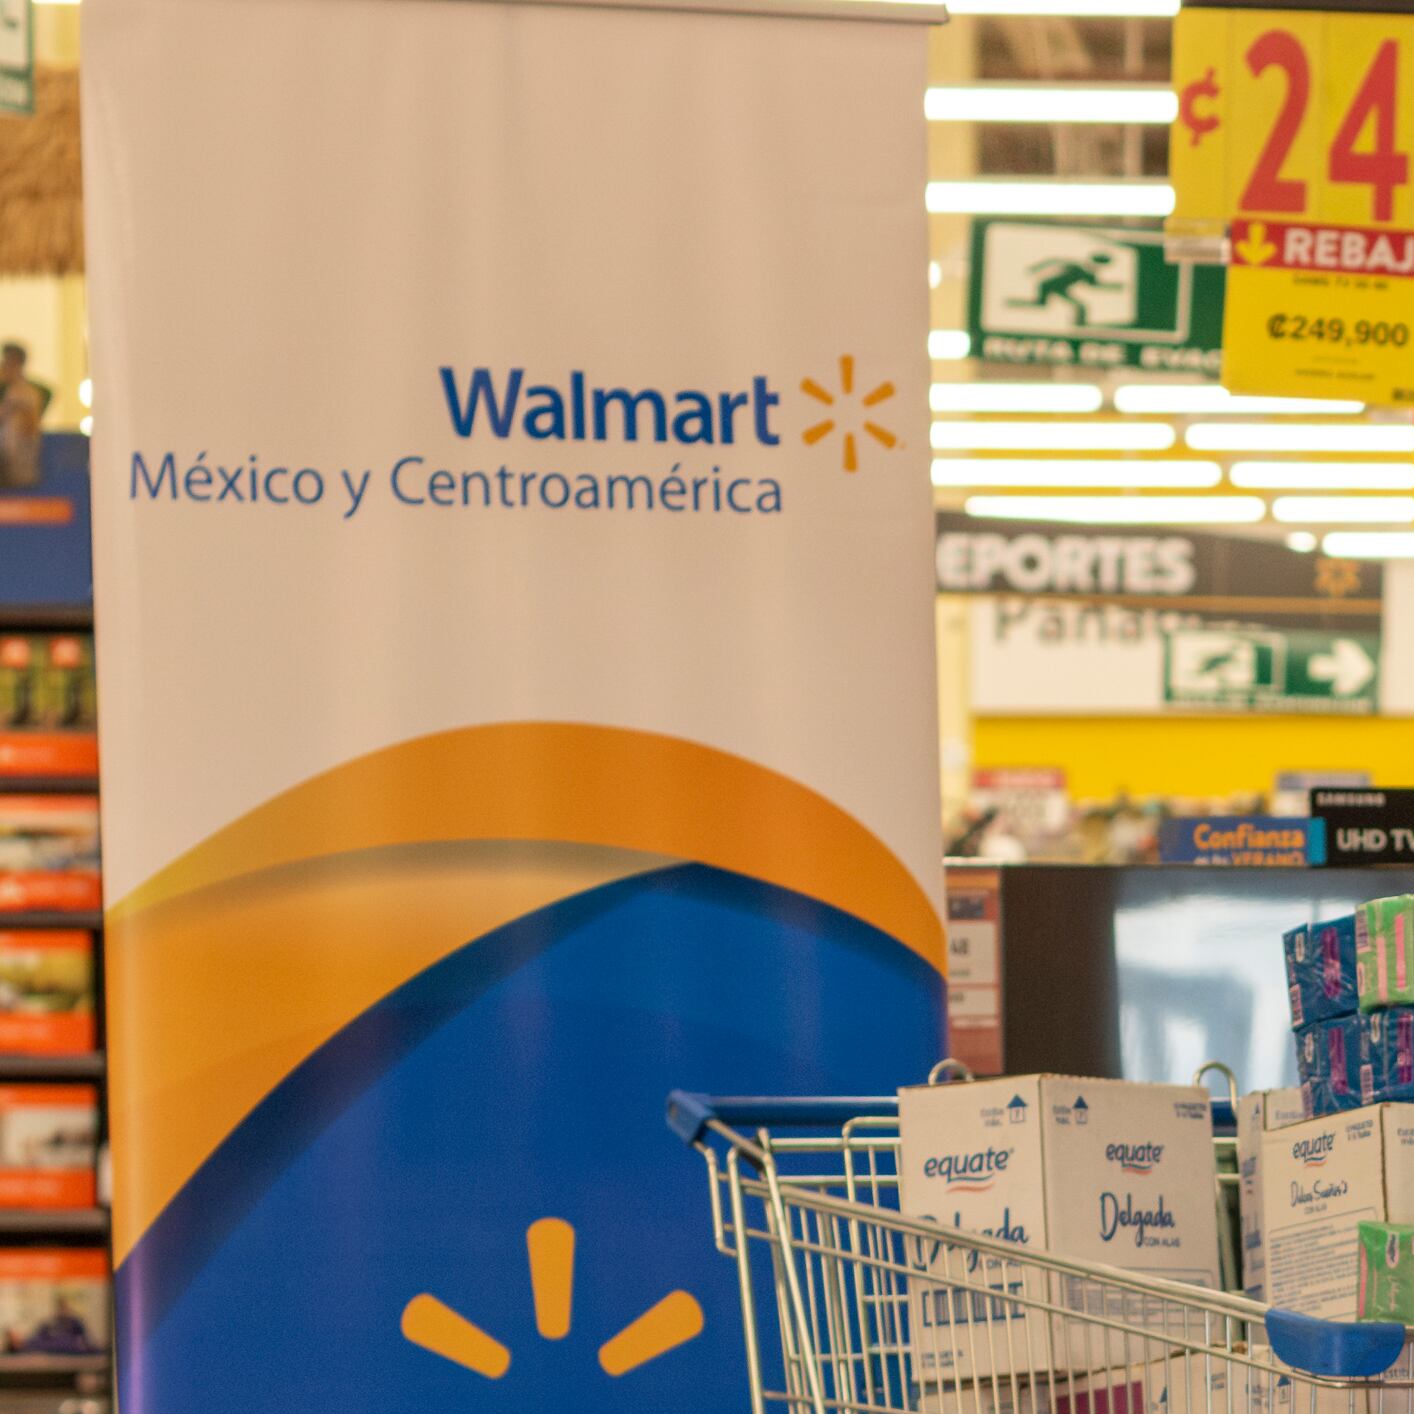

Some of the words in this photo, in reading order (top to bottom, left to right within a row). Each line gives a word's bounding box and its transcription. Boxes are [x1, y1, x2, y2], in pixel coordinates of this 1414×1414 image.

[439, 366, 781, 447] Walmart
[129, 450, 325, 505] México
[342, 469, 372, 520] y
[390, 455, 784, 516] Centroamérica
[1192, 822, 1305, 851] Confianza
[1336, 827, 1389, 852] UHD
[1105, 1142, 1164, 1168] equate
[1292, 1130, 1337, 1161] equate
[923, 1147, 1011, 1183] equate
[1100, 1191, 1176, 1248] Delgada
